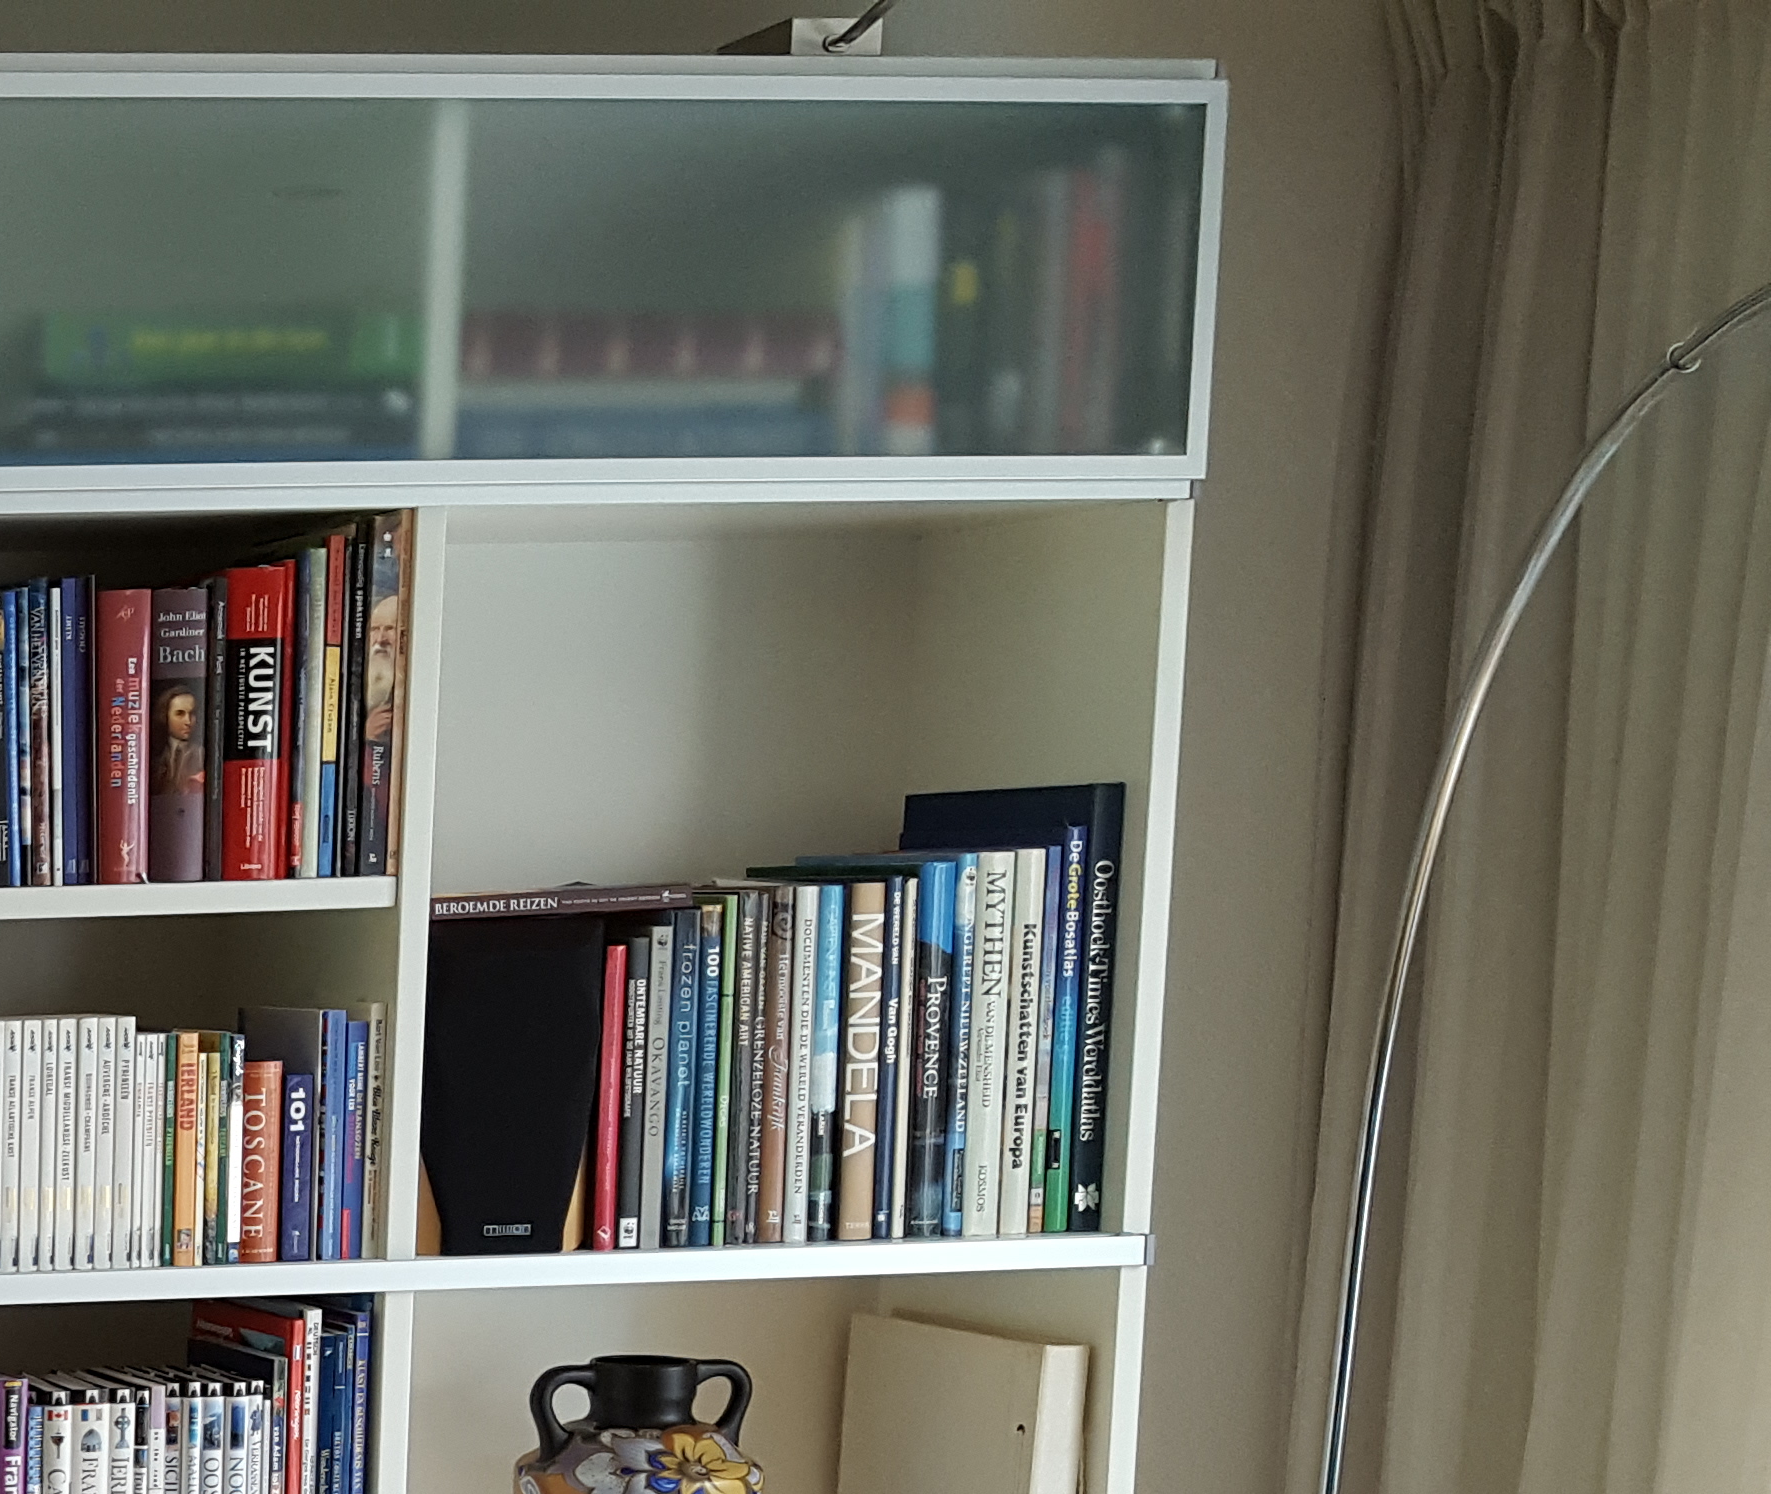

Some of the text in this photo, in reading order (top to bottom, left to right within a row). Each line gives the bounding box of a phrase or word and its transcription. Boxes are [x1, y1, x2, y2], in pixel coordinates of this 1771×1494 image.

[158, 647, 206, 663] Bach
[247, 647, 275, 752] KUNST
[110, 697, 124, 787] Nederlanden
[370, 746, 384, 785] Rubens
[435, 900, 507, 914] BEROEMDE
[508, 899, 558, 910] REIZEN
[981, 870, 1006, 998] MYTHEN
[706, 946, 719, 977] 100
[738, 918, 755, 1045] NATIVE AMERICAN ART
[632, 979, 646, 1094] ONTEMBARE NATUUR
[675, 944, 697, 1087] frozen planet
[843, 913, 884, 1156] MANDELA
[885, 999, 898, 1063] Van Gogh
[923, 976, 946, 1098] PROVENCE
[1009, 924, 1038, 1169] Kunstschatten van Europa
[179, 1063, 195, 1130] IERLAND
[290, 1087, 305, 1131] 101
[648, 1038, 665, 1136] OKAVANGO
[242, 1087, 266, 1239] TOSCANE
[8, 1395, 19, 1441] Navigator
